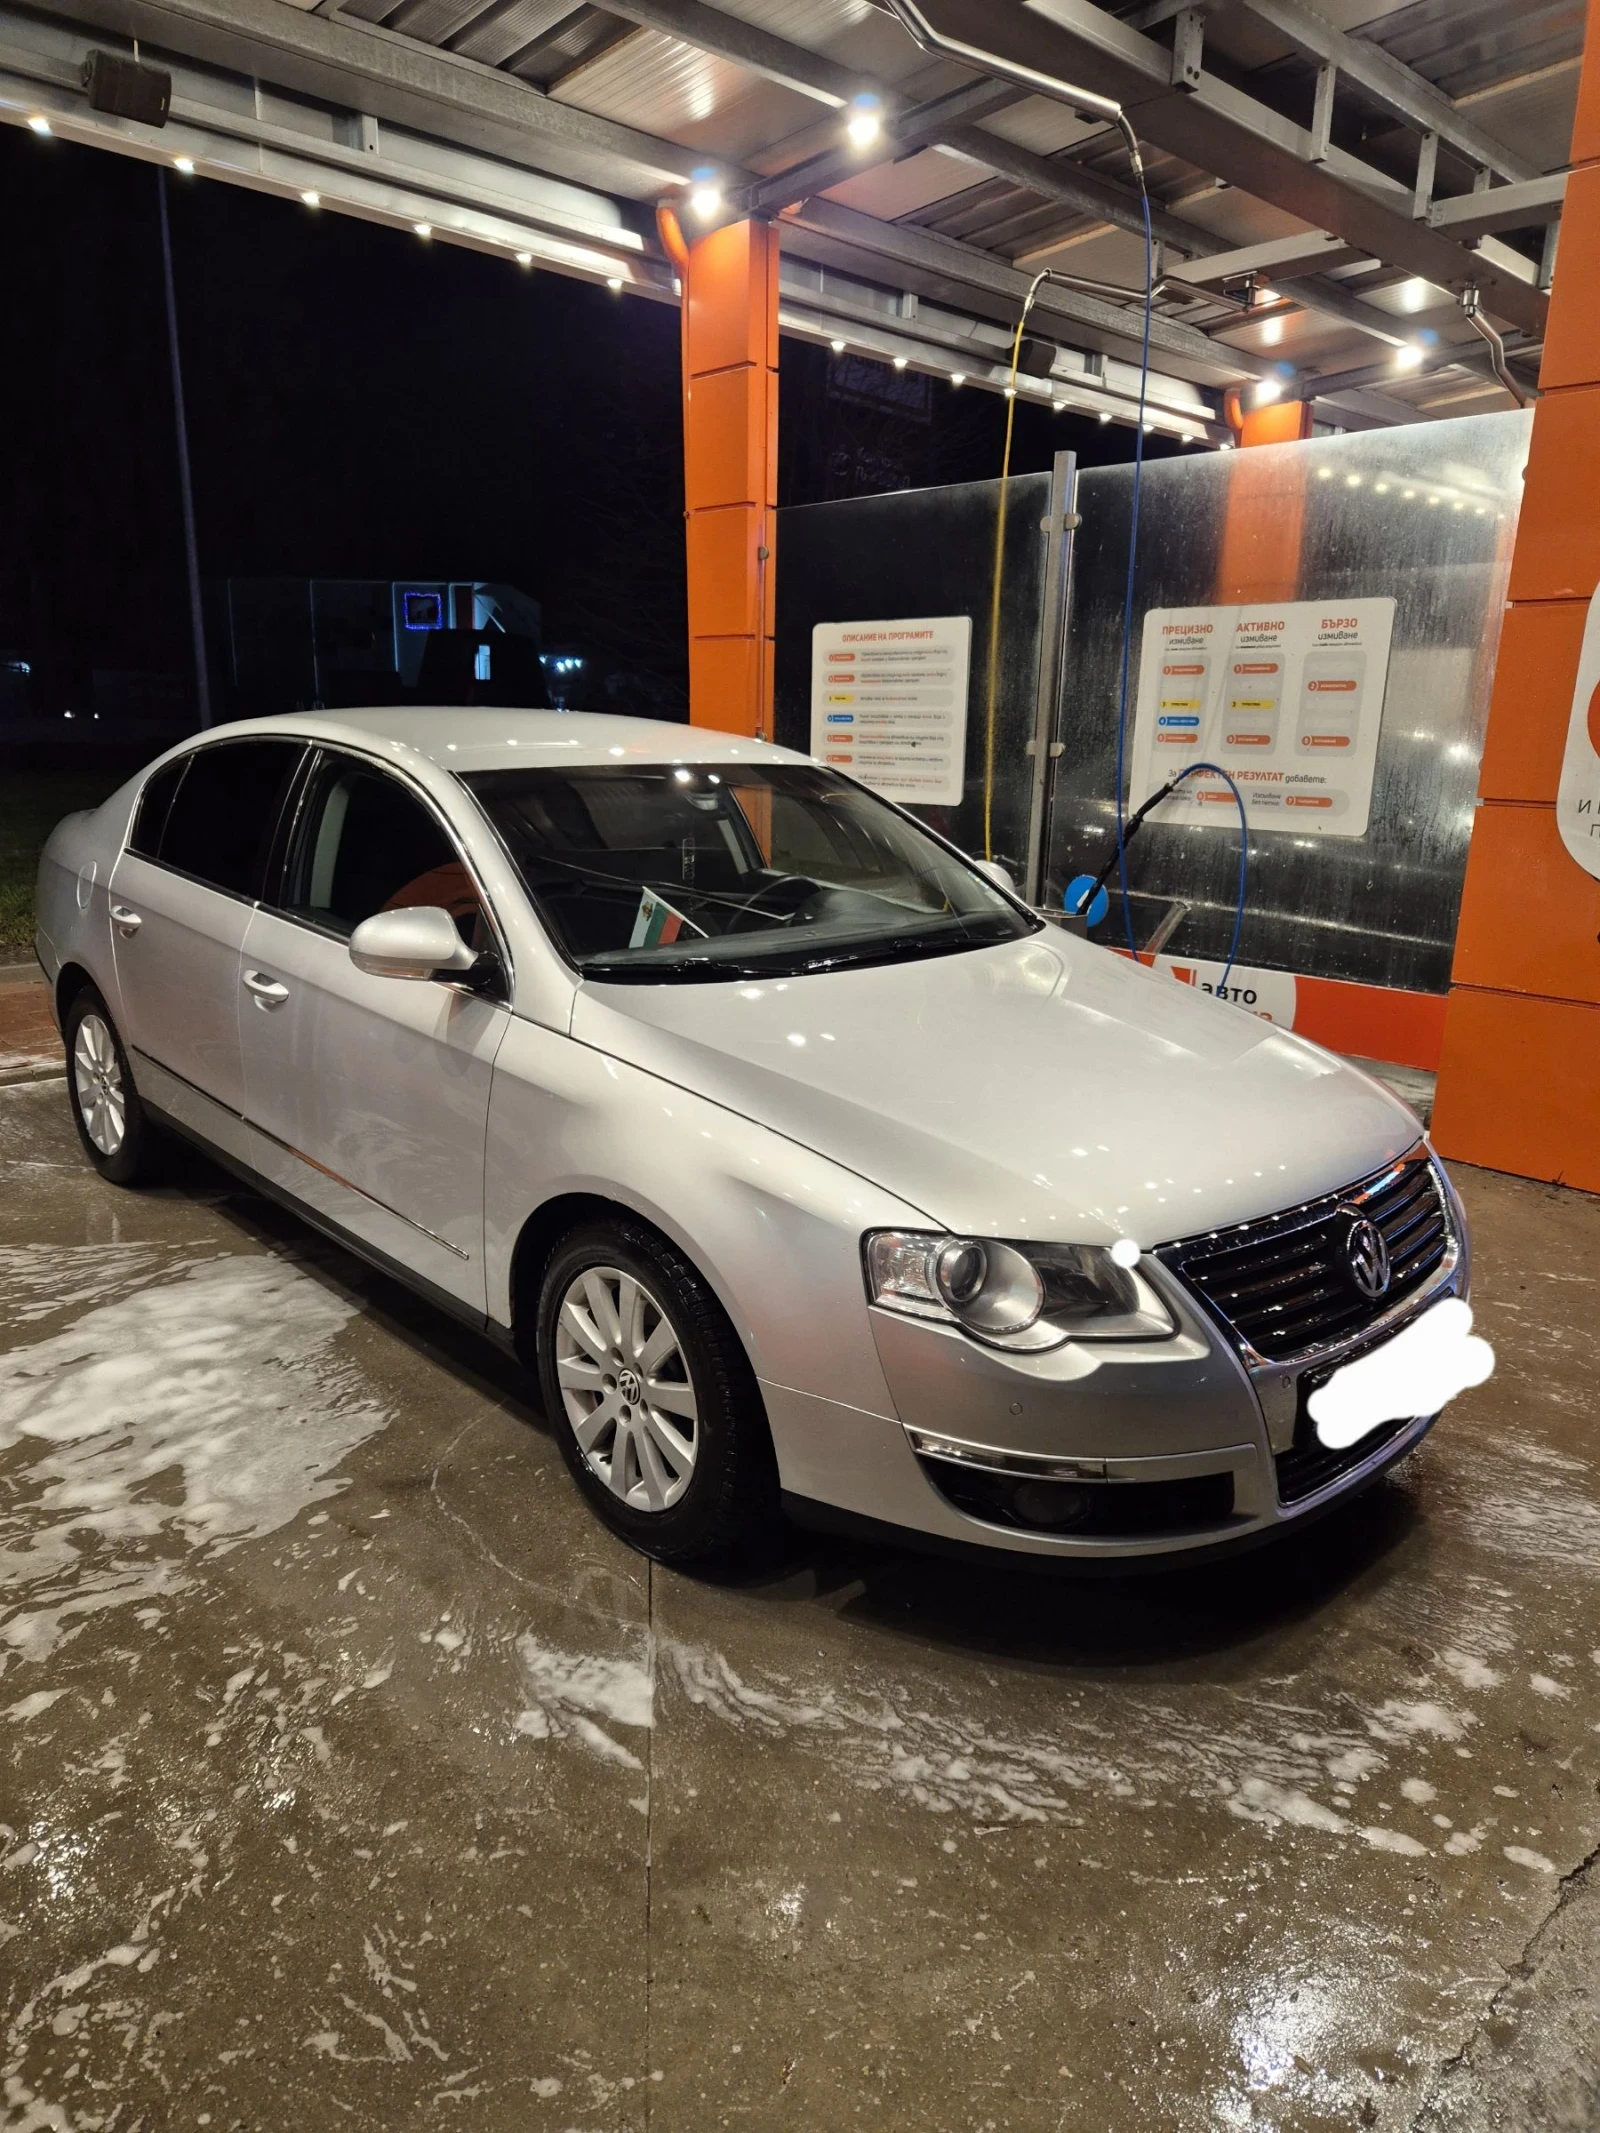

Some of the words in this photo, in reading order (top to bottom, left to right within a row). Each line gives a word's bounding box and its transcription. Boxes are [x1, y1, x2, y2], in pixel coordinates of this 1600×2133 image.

[1236, 621, 1285, 632] АКТИВНО
[1321, 618, 1358, 629] БЪРЗО
[1162, 624, 1214, 635] ПРЕЦИЗНО
[842, 633, 877, 643] ОПИСАНИЕ
[877, 632, 887, 641] НА
[888, 630, 934, 641] ПРОГРАМИТЕ
[1169, 636, 1204, 645] измиване
[1240, 633, 1278, 643] измиване
[1318, 631, 1358, 640] измиване
[1236, 770, 1285, 782] РЕЗУЛТАТ
[1201, 983, 1257, 1004] авто
